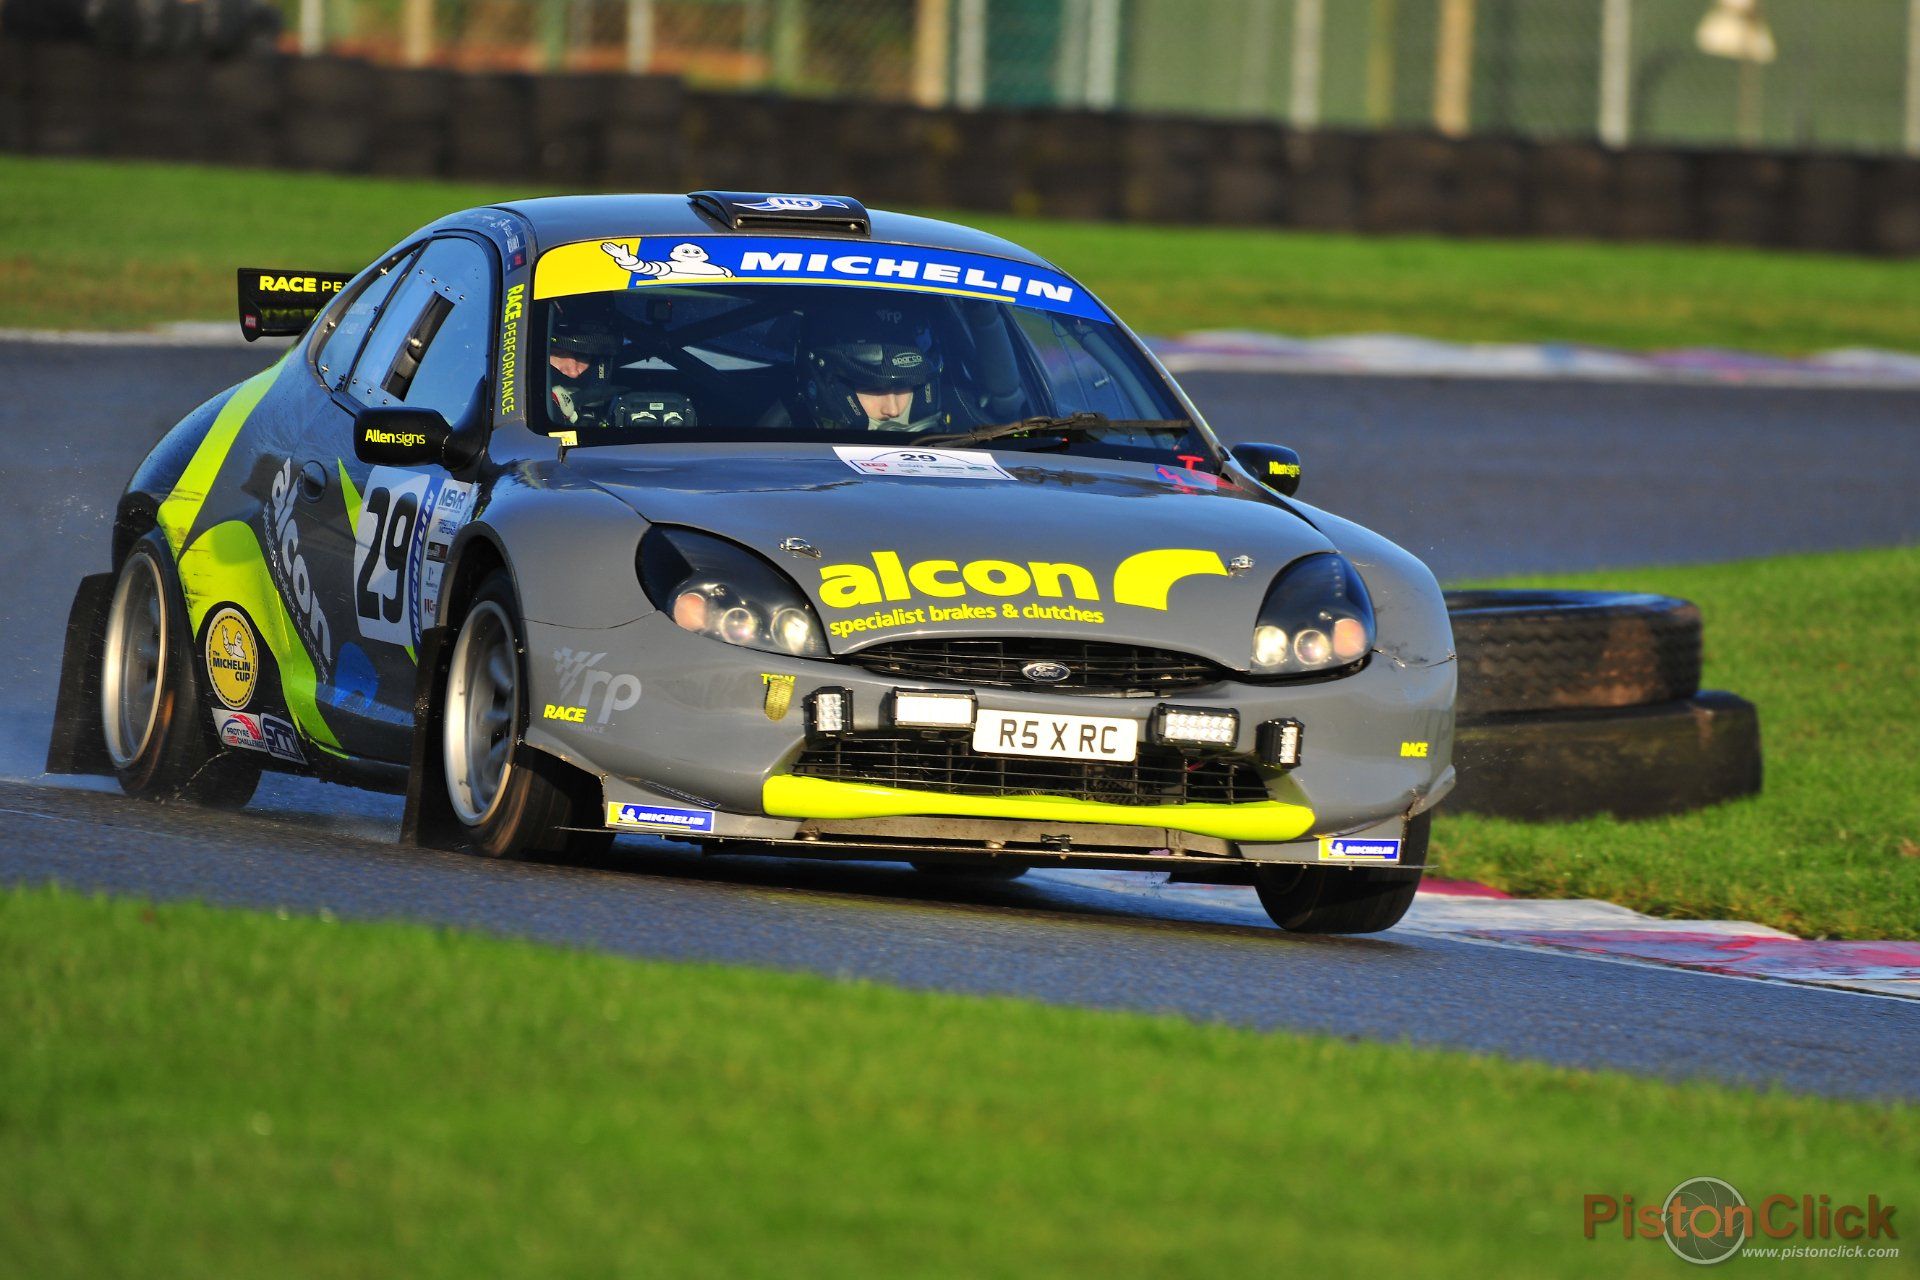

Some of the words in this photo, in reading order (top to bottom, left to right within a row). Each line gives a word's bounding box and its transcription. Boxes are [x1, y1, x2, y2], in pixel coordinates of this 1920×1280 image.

[259, 275, 316, 293] RACE
[321, 281, 347, 293] PE
[740, 251, 1073, 304] MICHELIN
[504, 283, 525, 324] RACE
[501, 321, 517, 416] PERFORMANCE
[900, 453, 937, 462] 29
[272, 457, 331, 667] alcon
[357, 487, 418, 624] 29
[411, 490, 435, 644] MICHELIN
[818, 551, 1100, 608] alcon
[829, 608, 926, 638] specialist
[930, 604, 997, 622] brakes
[1002, 604, 1019, 618] &
[1023, 605, 1105, 624] clutches
[213, 658, 251, 671] MICHELIN
[235, 672, 251, 682] CUP
[543, 704, 587, 723] RACE
[999, 718, 1039, 749] R5
[1050, 723, 1068, 751] X
[1080, 724, 1118, 754] RC
[1401, 742, 1428, 757] RACE
[638, 811, 706, 826] MICHELIN
[1345, 845, 1395, 855] MICHELIN
